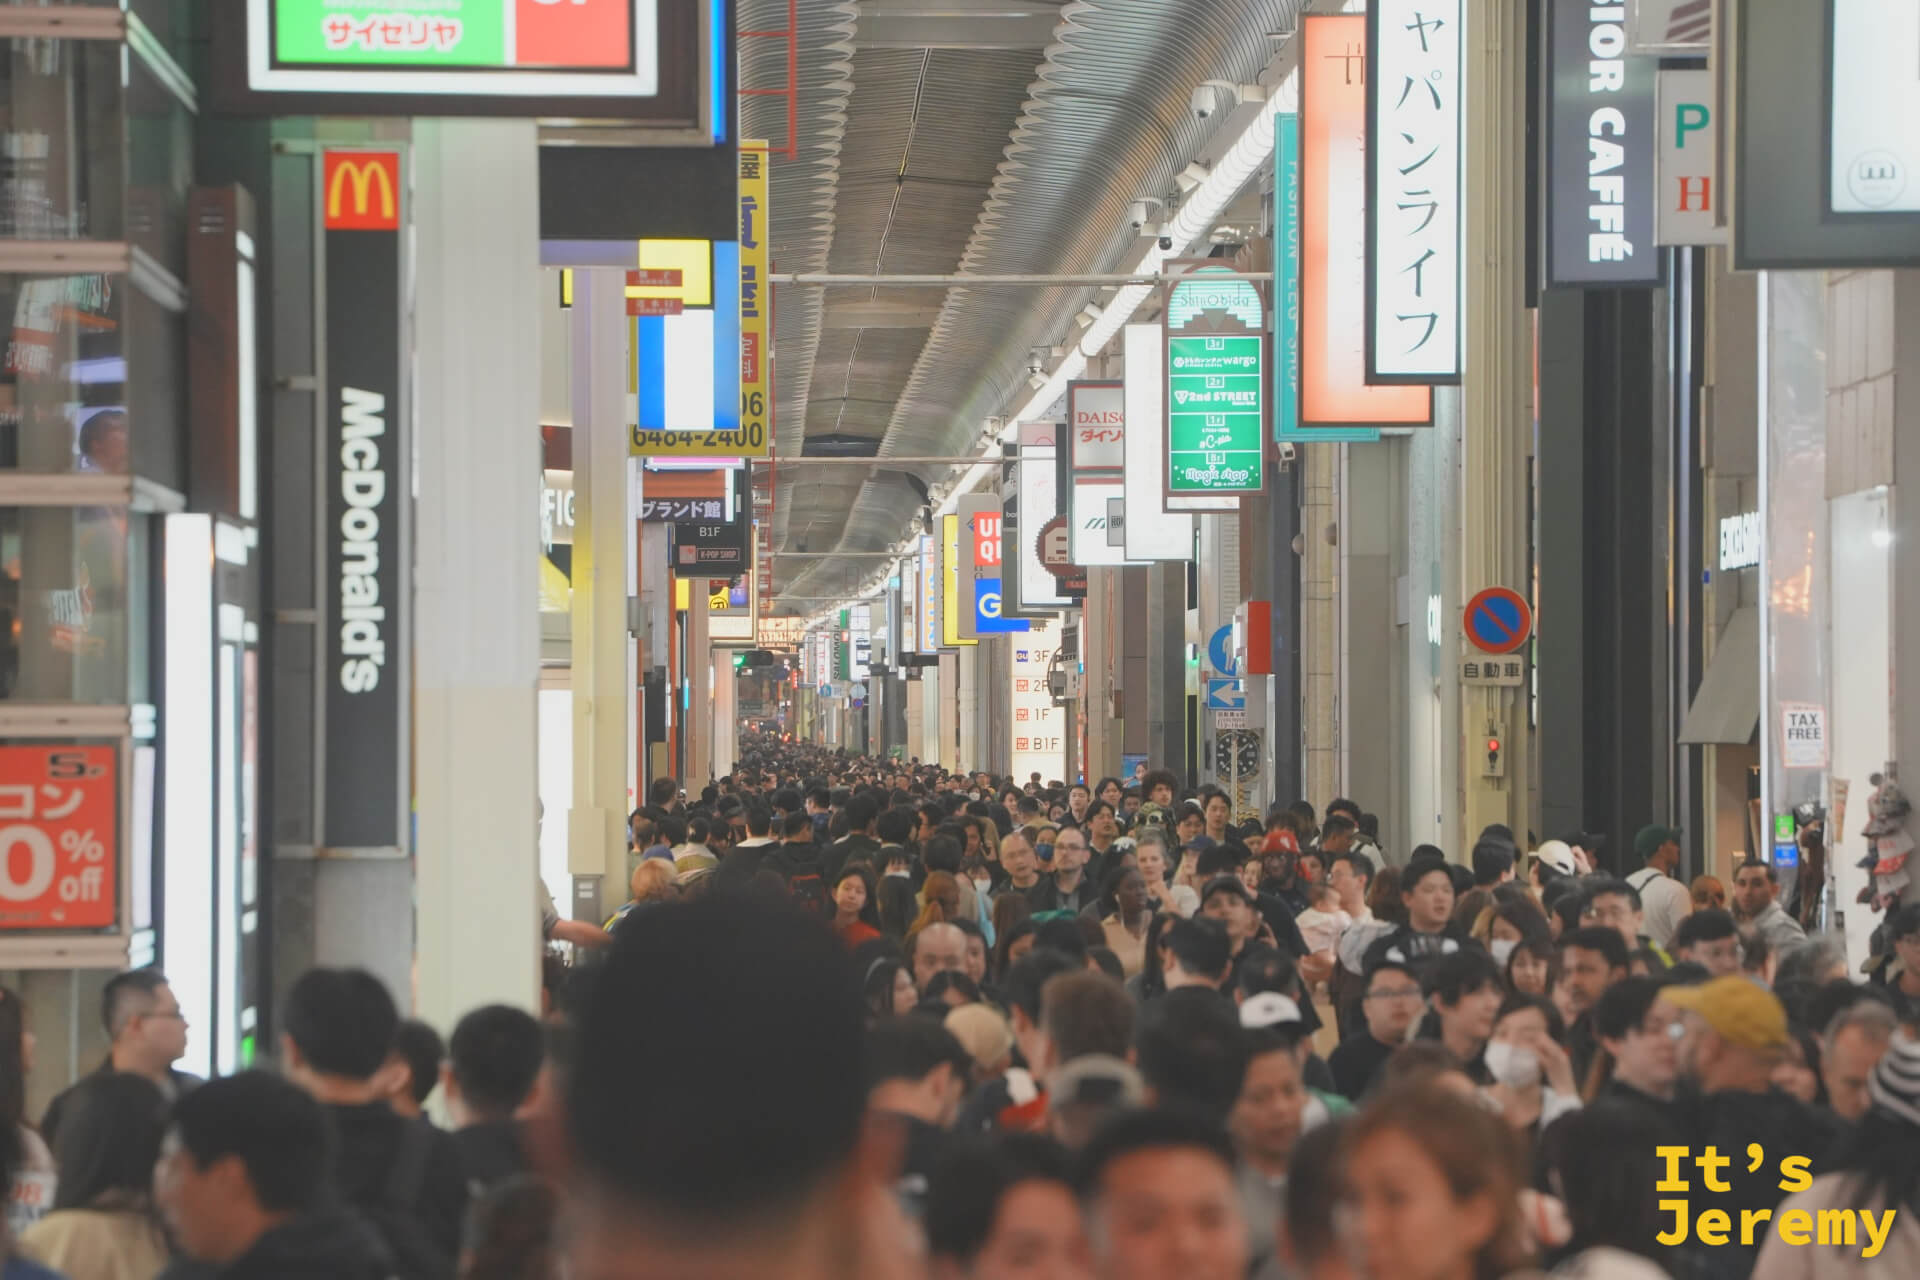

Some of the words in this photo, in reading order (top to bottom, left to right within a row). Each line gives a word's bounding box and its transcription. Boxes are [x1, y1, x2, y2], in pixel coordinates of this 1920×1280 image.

[1589, 0, 1625, 92] IOR
[1588, 106, 1633, 263] CAFFÉ
[1188, 391, 1211, 401] 2nd
[1213, 391, 1257, 401] STREET
[1080, 428, 1124, 443] ダイソ
[699, 526, 721, 537] B1F
[340, 386, 385, 694] McDonald's
[1463, 663, 1521, 679] 自動車
[1788, 713, 1818, 726] TAX
[1788, 728, 1822, 740] FREE
[1033, 738, 1061, 750] B1F
